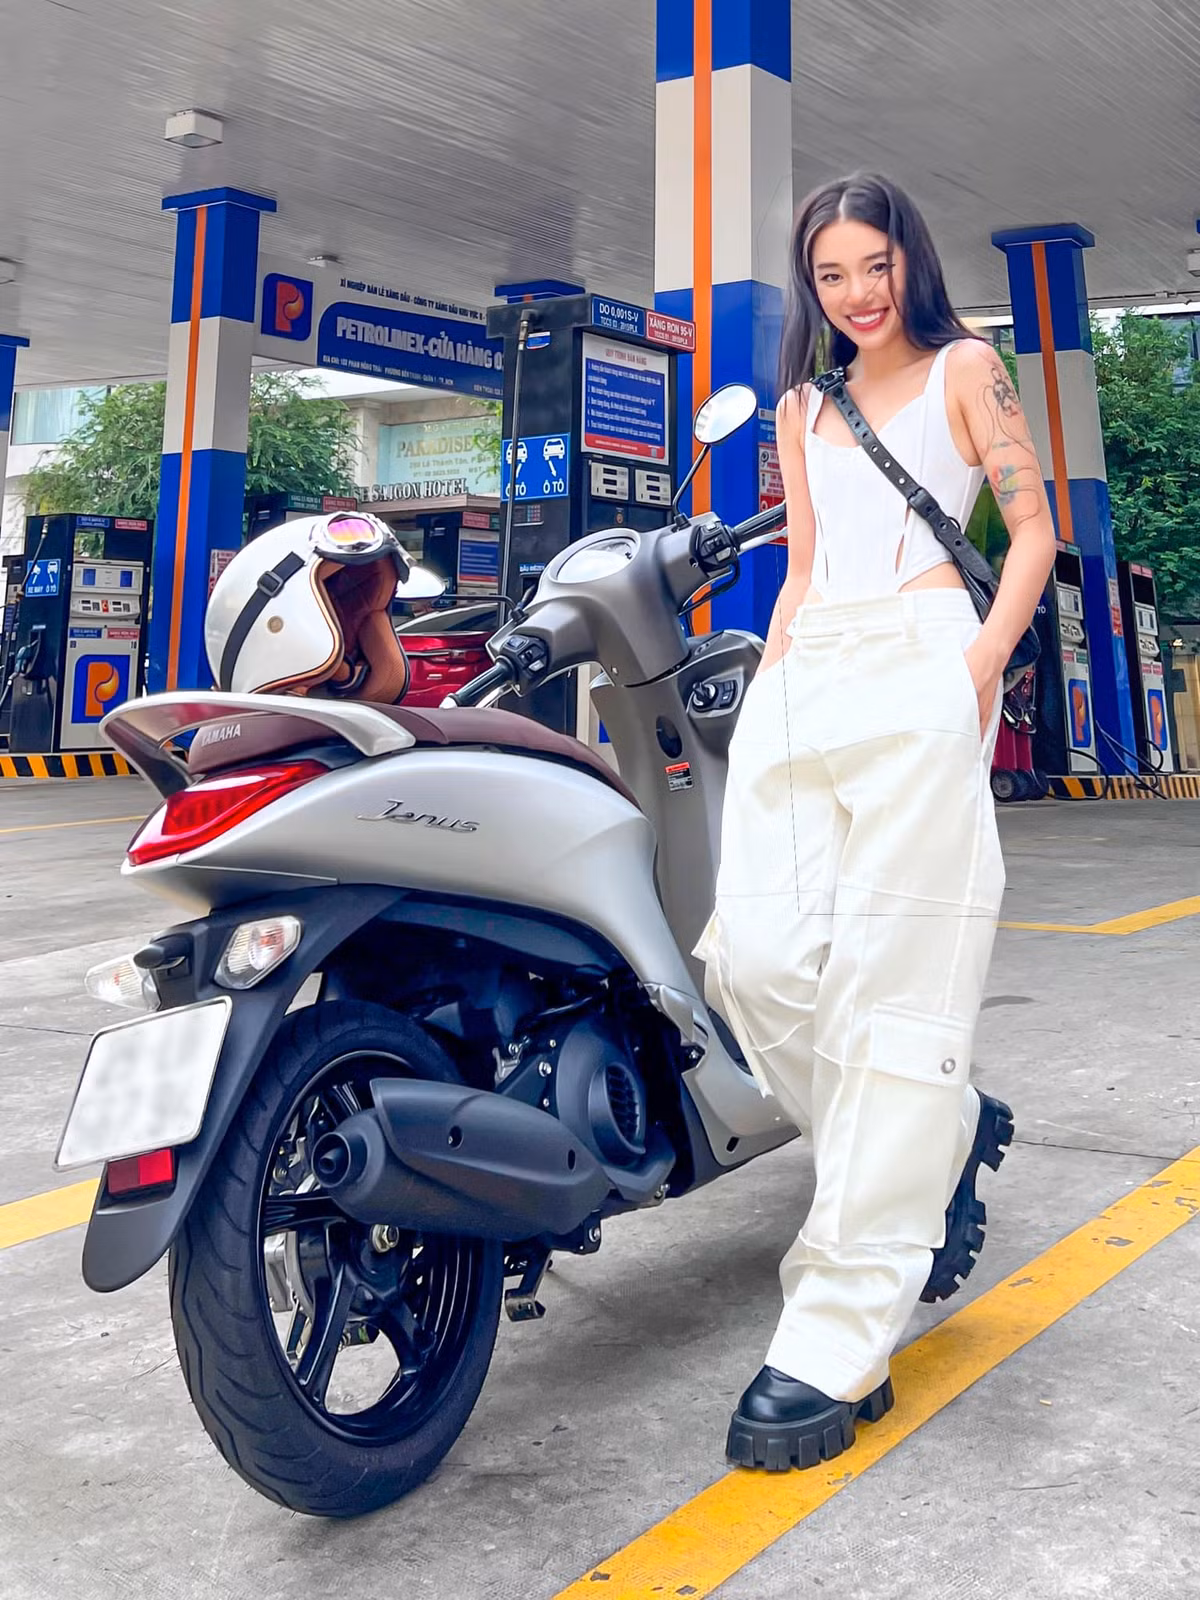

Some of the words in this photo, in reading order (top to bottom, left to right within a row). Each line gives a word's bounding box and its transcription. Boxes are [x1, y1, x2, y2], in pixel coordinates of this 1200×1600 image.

[599, 302, 610, 315] DO
[667, 320, 680, 335] RON
[456, 340, 493, 369] HÀNG
[396, 434, 473, 459] PARADISE
[370, 481, 421, 502] SAIGON
[423, 478, 467, 499] HOTEL
[515, 481, 527, 497] TÔ
[543, 479, 550, 494] Ô
[552, 477, 564, 493] TÔ
[201, 723, 241, 747] YAMAHA
